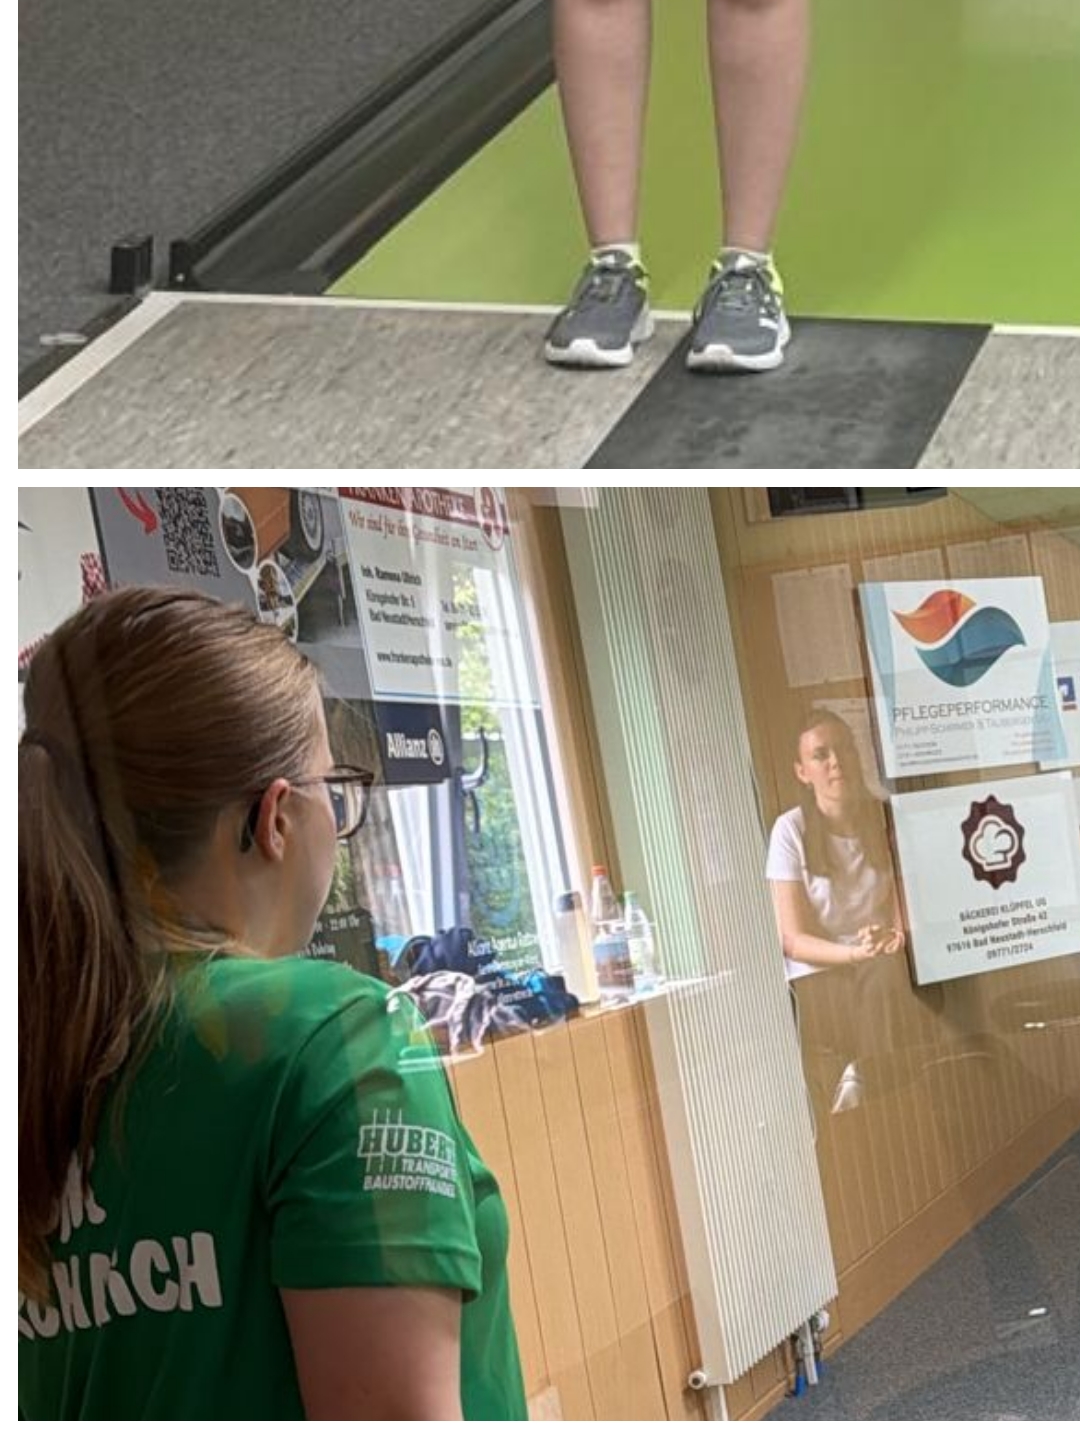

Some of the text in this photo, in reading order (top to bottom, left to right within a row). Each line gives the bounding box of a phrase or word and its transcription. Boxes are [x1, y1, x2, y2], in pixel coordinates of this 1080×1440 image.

[892, 695, 1049, 723] PFLEGEPERFORMANCE
[386, 732, 429, 759] Allianz
[959, 905, 1000, 922] BÄCKEREI
[963, 919, 1010, 935] Königshofer
[1011, 912, 1036, 926] Straße
[973, 937, 988, 948] Bad
